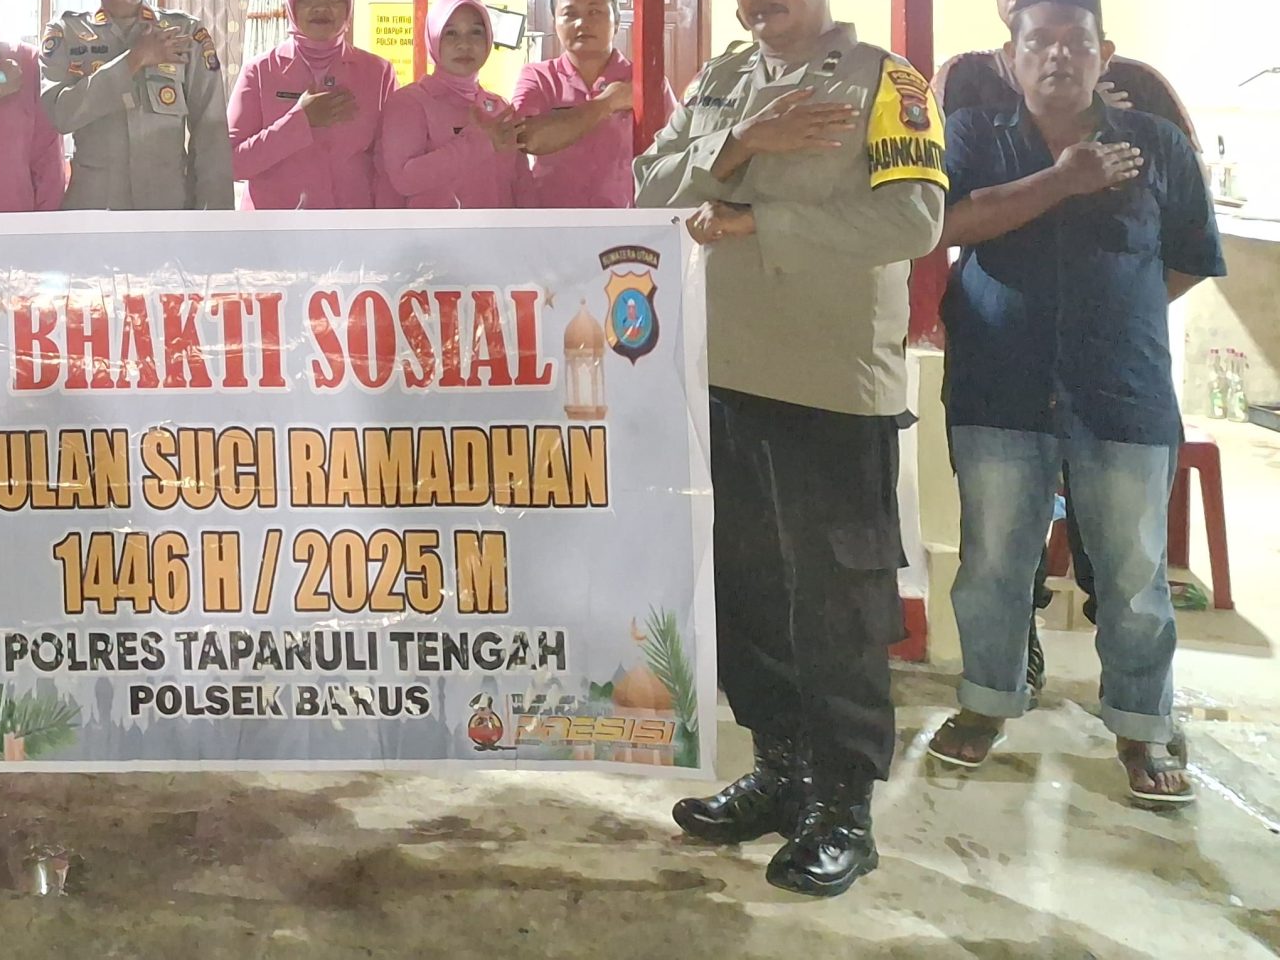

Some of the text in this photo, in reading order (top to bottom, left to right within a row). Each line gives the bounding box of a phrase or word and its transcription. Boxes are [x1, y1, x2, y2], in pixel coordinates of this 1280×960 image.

[13, 290, 553, 390] BHAKTI SOSIAL
[140, 426, 278, 511] SUCI
[287, 424, 609, 509] RAMADHAN
[52, 528, 509, 615] 1446 H / 2025 M
[4, 630, 567, 672] POLRES TAPANULI TENGAH
[128, 684, 284, 717] POLSEK
